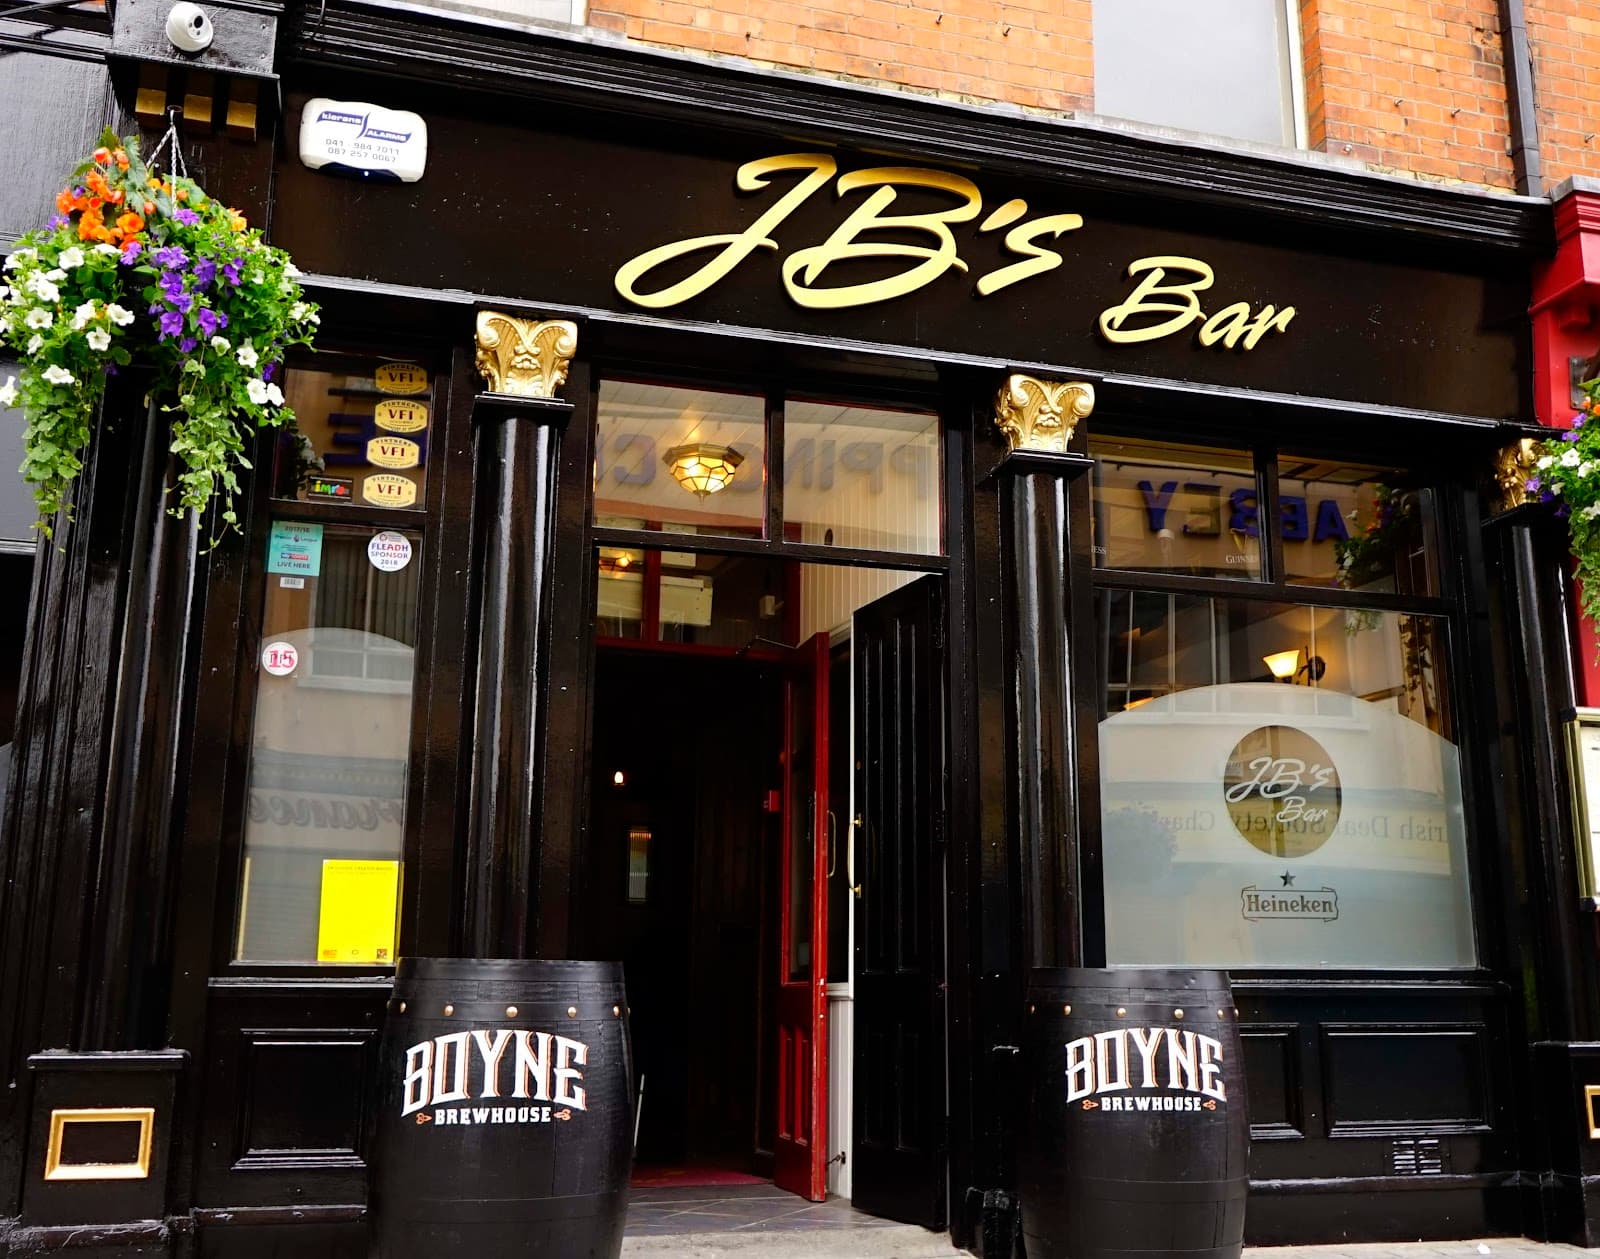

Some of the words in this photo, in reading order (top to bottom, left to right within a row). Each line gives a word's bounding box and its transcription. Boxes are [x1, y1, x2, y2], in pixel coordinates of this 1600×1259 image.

[366, 129, 407, 142] ALARMS
[353, 141, 373, 151] 984
[350, 149, 369, 159] 257
[614, 152, 1084, 310] JB's
[1099, 255, 1297, 351] Bar
[388, 372, 413, 383] VFI
[388, 408, 413, 421] VFI
[380, 445, 405, 457] VFI
[377, 483, 402, 496] VFI
[370, 543, 409, 552] FLEADH
[370, 551, 408, 559] SPONSOR
[1225, 756, 1335, 804] JB's
[1276, 796, 1330, 824] Bar
[1246, 894, 1335, 914] Heineken
[1064, 1026, 1228, 1105] BOYNE
[401, 1028, 589, 1119] BOYNE
[1100, 1096, 1203, 1112] BREWHOUSE
[433, 1106, 552, 1126] BREWHOUSE
